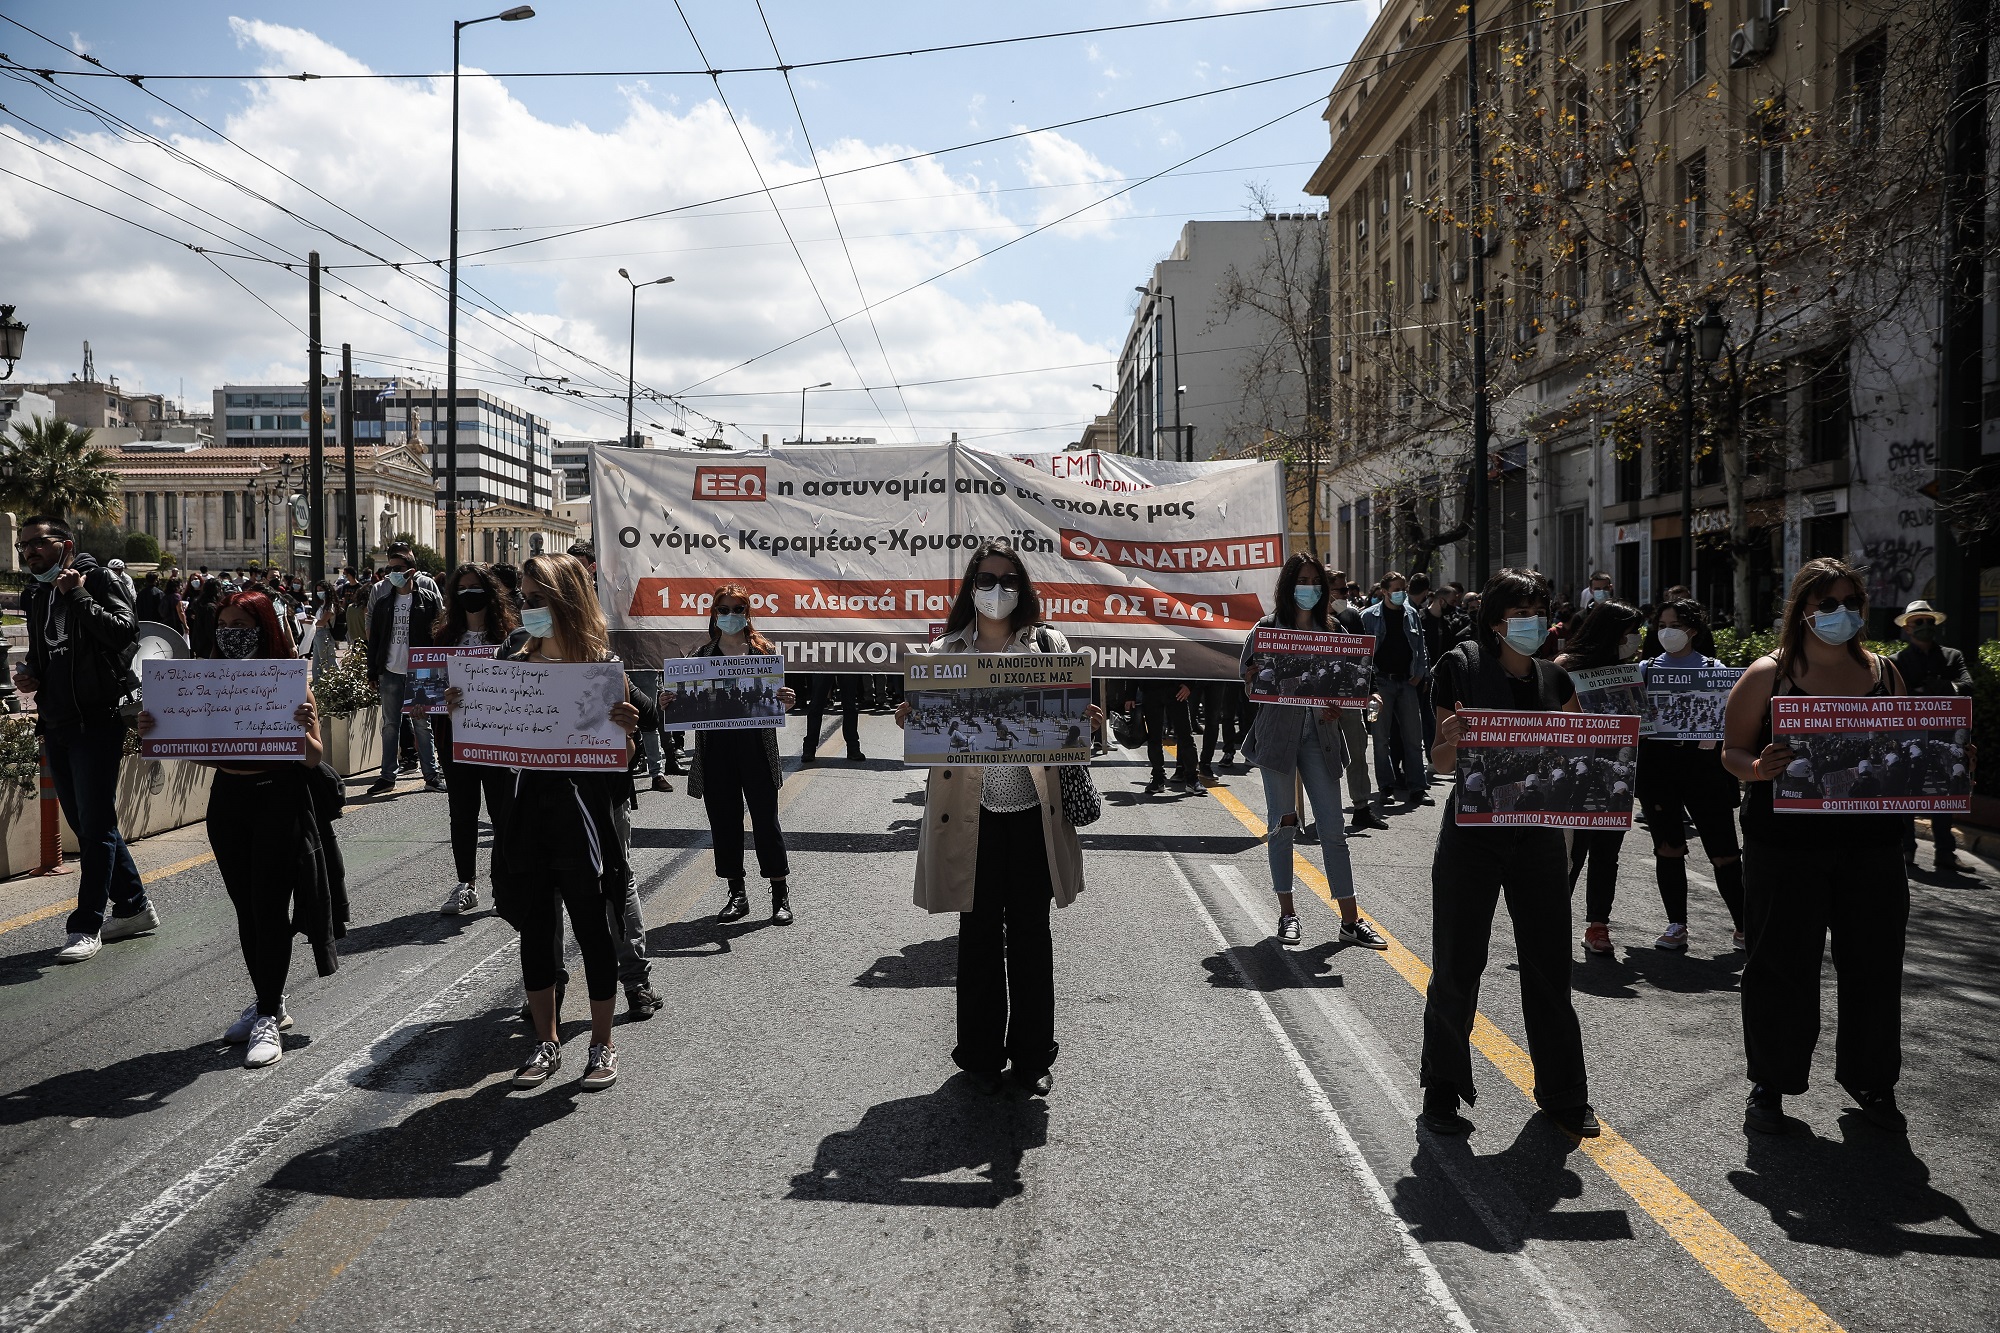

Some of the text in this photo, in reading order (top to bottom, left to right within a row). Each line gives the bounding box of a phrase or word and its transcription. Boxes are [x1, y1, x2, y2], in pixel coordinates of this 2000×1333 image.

[701, 473, 762, 496] ΕΞΩ
[778, 480, 793, 496] η
[802, 471, 946, 501] αστυνομία
[955, 477, 1007, 498] από
[1014, 487, 1045, 505] τις
[1147, 500, 1196, 523] μας
[618, 526, 641, 548] Ο
[650, 525, 730, 554] νόμος
[1069, 537, 1112, 558] ΘΑ
[1119, 541, 1275, 569] ΑΝΑΤΡΑΠΕΙ
[657, 589, 669, 609] 1
[680, 592, 779, 614] χρος
[794, 587, 896, 612] κλειστά
[1103, 594, 1147, 616] ΩΣ
[1258, 631, 1271, 639] ΕΞΩ
[1278, 633, 1313, 642] ΑΣΤΥΝΟΜΙΑ
[1340, 637, 1363, 645] ΣΧΟΛΕΣ
[1291, 644, 1333, 653] ΕΓΚΛΗΜΑΤΙΕΣ
[1342, 646, 1371, 655] ΦΟΙΤΗΤΕΣ
[411, 654, 425, 663] ΩΣ
[710, 657, 780, 667] ΝΑ ΑΝΟΙΞΟΥΝ ΤΩΡΑ
[977, 656, 1085, 669] ΝΑ ΑΝΟΙΞΟΥΝ ΤΩΡΑ
[668, 664, 704, 676] ΩΣ ΕΔΩ!
[727, 668, 755, 676] ΣΧΟΛΕΣ
[910, 664, 967, 679] ΩΣ ΕΔΩ!
[1578, 665, 1638, 680] ΝΑ ΑΝΟΙΞΟΥΝ ΤΩΡΑ
[1698, 670, 1711, 678] ΝΑ
[990, 671, 1073, 683] ΟΙ ΣΧΟΛΕΣ ΜΑΣ
[1589, 675, 1635, 688] ΟΙ ΣΧΟΛΕΣ ΜΑΣ
[1652, 674, 1691, 684] ΩΣ ΕΔΩ!
[1706, 680, 1715, 688] ΟΙ
[1277, 697, 1312, 705] ΦΟΙΤΗΤΙΚΟΙ
[1778, 701, 1952, 713] ΕΞΩ Η ΑΣΤΥΝΟΜΙΑ ΑΠΟ ΤΙΣ ΣΧΟΛΕΣ
[691, 721, 727, 729] ΦΟΙΤΗΤΙΚΟΙ
[727, 720, 757, 728] ΣΥΛΛΟΓΟΙ
[1463, 717, 1621, 729] ΞΩ Η ΑΣΤΥΝΟΜΙΑ ΑΠΟ ΤΙΣ ΣΧΟΛΕΣ
[1778, 716, 1967, 728] ΔΕΝ ΕΙΝΑΙ ΕΓΚΛΗΜΑΤΙΕΣ ΟΙ ΦΟΙΤΗΤΕΣ
[1480, 732, 1507, 742] ΕΙΝΑΙ
[1509, 732, 1574, 744] ΕΓΚΛΗΜΑΤΙΕΣ
[1577, 734, 1586, 744] ΟΙ
[1589, 735, 1633, 745] ΦΟΙΤΗΤΕΣ
[1677, 732, 1715, 740] ΦΟΙΤΗΤΙΚΟΙ
[152, 742, 298, 754] ΦΟΙΤΗΤΙΚΟΙ ΣΥΛΛΟΓΟΙ ΑΘΗΝΑΣ
[463, 749, 618, 764] ΦΟΙΤΗΤΙΚΟΙ ΣΥΛΛΟΓΟΙ ΑΘΗΝΑΣ
[946, 752, 1086, 764] ΦΟΙΤΗΤΙΚΟΙ ΣΥΛΛΟΓΟΙ ΑΘΗΝΑΣ
[1822, 799, 1967, 811] ΦΟΙΤΗΤΙΚΟΙ ΣΥΛΛΟΓΟΙ ΑΘΗΝΑΣ
[1491, 814, 1628, 826] ΦΟΙΤΗΤΙΚΟΙ ΣΥΛΛΟΓΟΙ ΑΘΗΝΑΣ
